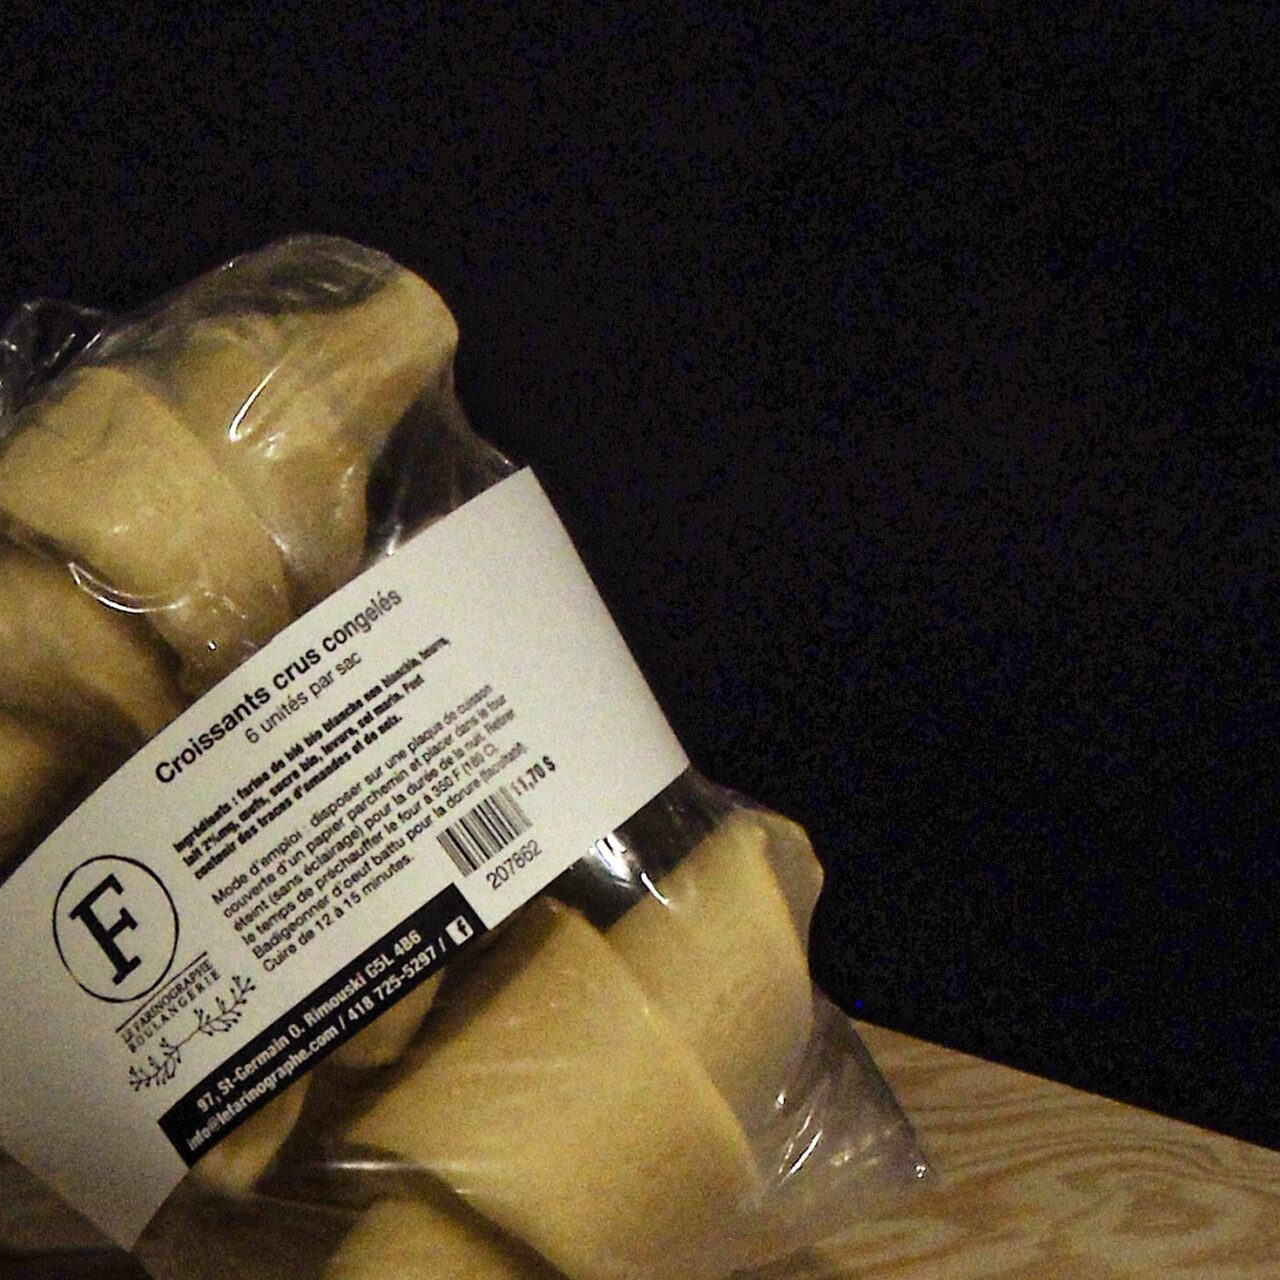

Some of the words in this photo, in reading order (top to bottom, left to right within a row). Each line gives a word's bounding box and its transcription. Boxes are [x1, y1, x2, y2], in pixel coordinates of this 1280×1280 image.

[155, 687, 271, 784] Croissants
[272, 648, 321, 691] crus
[322, 590, 402, 653] congelés
[244, 727, 260, 744] 6
[259, 691, 309, 734] unités
[308, 670, 335, 699] par
[335, 652, 362, 676] sac
[211, 873, 249, 905] Mode
[248, 830, 303, 876] d'emploi
[309, 781, 363, 828] disposer
[363, 765, 384, 786] sur
[384, 749, 408, 770] une
[406, 721, 444, 755] plaque
[442, 711, 458, 726] de
[223, 873, 277, 919] couverte
[276, 849, 306, 876] d'un
[305, 817, 345, 856] papier
[346, 769, 410, 824] parchemin
[409, 757, 423, 772] et
[421, 733, 453, 765] placer
[454, 715, 480, 738] dans
[233, 899, 270, 932] éteint
[268, 874, 304, 906] (sans
[303, 824, 365, 877] éclairage)
[363, 802, 392, 832] pour
[391, 793, 408, 806] la
[406, 768, 439, 796] durée
[438, 756, 455, 771] de
[451, 747, 466, 760] la
[241, 932, 257, 946] le
[255, 901, 297, 935] temps
[296, 887, 314, 904] de
[314, 830, 384, 892] préchauffer
[383, 821, 399, 835] le
[397, 800, 422, 824] four
[430, 775, 455, 798] 350
[451, 767, 461, 782] F
[251, 894, 330, 960] Badigeonner
[331, 860, 373, 898] d'oeuf
[369, 837, 406, 867] battu
[405, 814, 433, 843] pour
[431, 805, 448, 818] la
[445, 778, 481, 809] dorure
[485, 839, 542, 891] 207862
[68, 873, 142, 986] F
[126, 959, 217, 1033] FARINOGRAPHE
[262, 943, 298, 972] Cuire
[297, 929, 316, 946] de
[315, 912, 334, 931] 12
[334, 906, 345, 919] à
[343, 891, 362, 909] 15
[361, 854, 412, 896] minutes.
[121, 1028, 135, 1044] LE
[123, 969, 221, 1054] BOULANGERIE
[188, 1025, 340, 1151] info@lefarinographe.com
[347, 995, 375, 1021] 418
[372, 945, 437, 1001] 725-5297
[196, 1091, 222, 1113] 97,
[217, 1035, 290, 1096] St-Germain
[287, 1023, 306, 1039] O.
[303, 972, 367, 1027] Rimouski
[364, 953, 395, 979] G5L
[394, 929, 422, 956] 4B6
